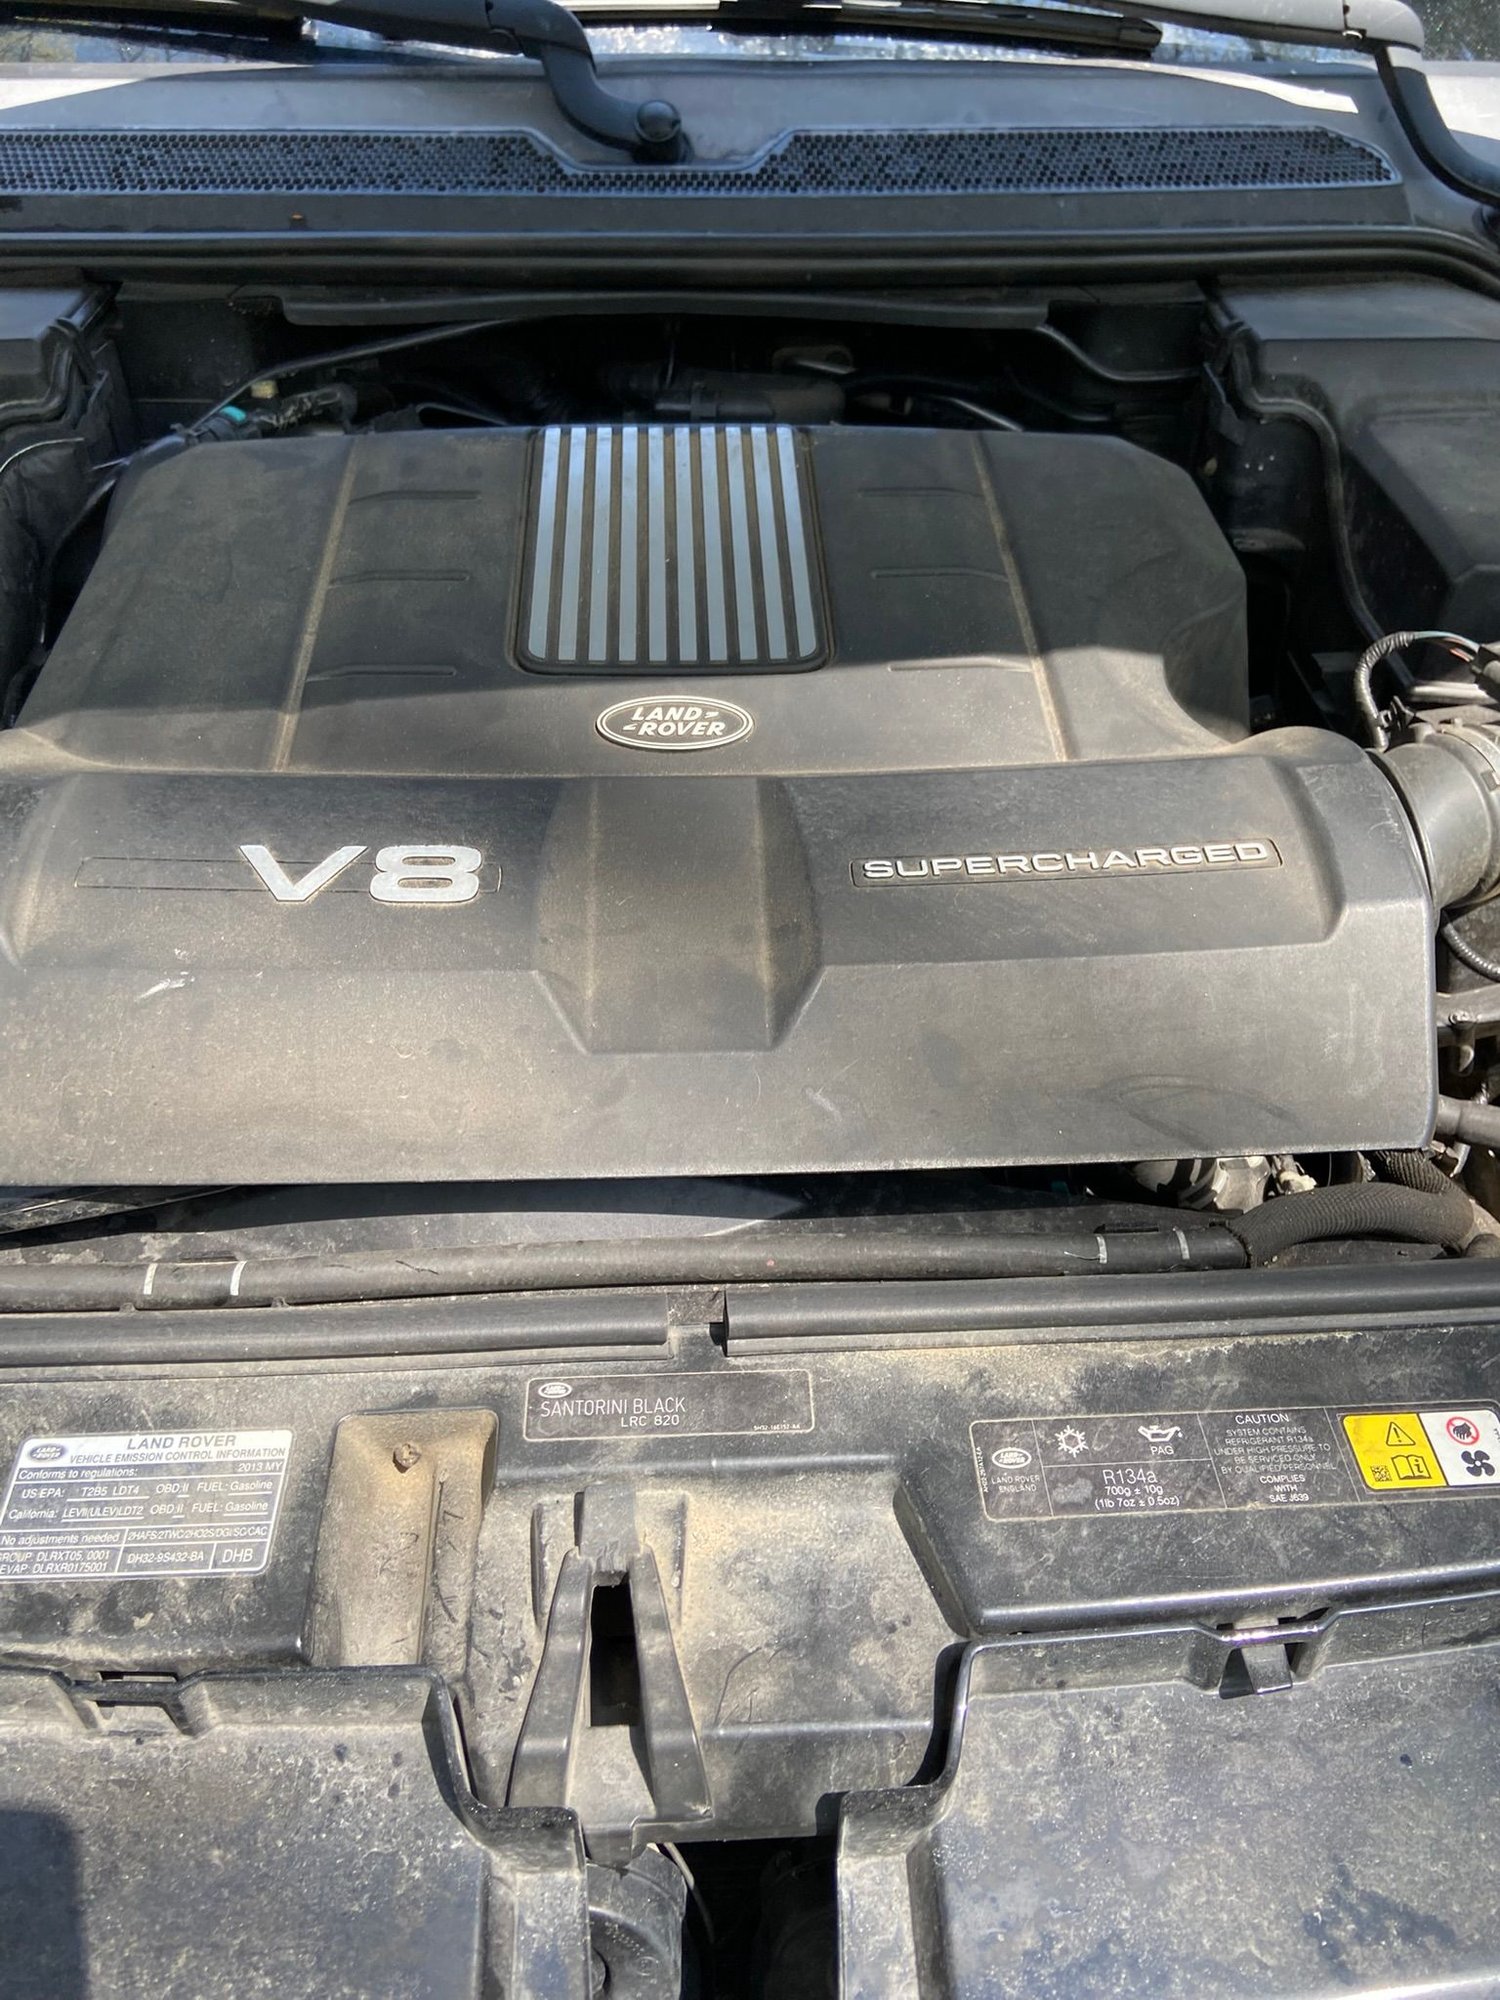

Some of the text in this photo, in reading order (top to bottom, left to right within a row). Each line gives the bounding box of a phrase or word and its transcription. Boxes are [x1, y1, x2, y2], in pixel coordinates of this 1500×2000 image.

[631, 707, 702, 721] LAND
[637, 721, 726, 736] ROVER
[862, 842, 1268, 879] SUPERCHARGED
[238, 845, 482, 902] V8
[540, 1397, 686, 1418] SANTORINI BLACK
[620, 1415, 680, 1427] LRC 820
[1235, 1413, 1290, 1424] CAUTION
[1226, 1426, 1306, 1437] SYSTEM CONTAINS
[127, 1435, 236, 1450] LAND ROVER
[1225, 1437, 1284, 1446] REFRIGERANT
[70, 1448, 286, 1464] VEHICLE EMISSION CONTROL INFORMATION
[1150, 1445, 1175, 1455] PAG
[1213, 1443, 1331, 1456] UNDER HIGH PRESSURE TO
[1248, 1454, 1292, 1463] SERVICED
[238, 1461, 283, 1472] 2013 MY
[1221, 1462, 1337, 1474] BY QUALIFIED PERSONNEL
[18, 1467, 138, 1480] Conforms to regulations:
[991, 1474, 1040, 1485] LAND ROVER
[1102, 1468, 1158, 1485] R134a
[1260, 1474, 1306, 1484] COMPLIES
[21, 1488, 37, 1499] US
[39, 1487, 65, 1498] EPA:
[112, 1485, 140, 1496] LDT4
[230, 1480, 273, 1491] Gasoline
[998, 1483, 1036, 1493] ENGLAND
[1104, 1486, 1131, 1497] 700g
[1144, 1484, 1164, 1496] 10g
[1274, 1484, 1299, 1493] WITH
[1116, 1497, 1136, 1507] 7oz
[1147, 1496, 1180, 1507] 0.5oz)
[1269, 1493, 1288, 1502] SAE
[8, 1508, 59, 1520] California:
[225, 1501, 268, 1512] Gasoline
[1, 1532, 120, 1547] No adjustments needed
[222, 1548, 254, 1563] DHB
